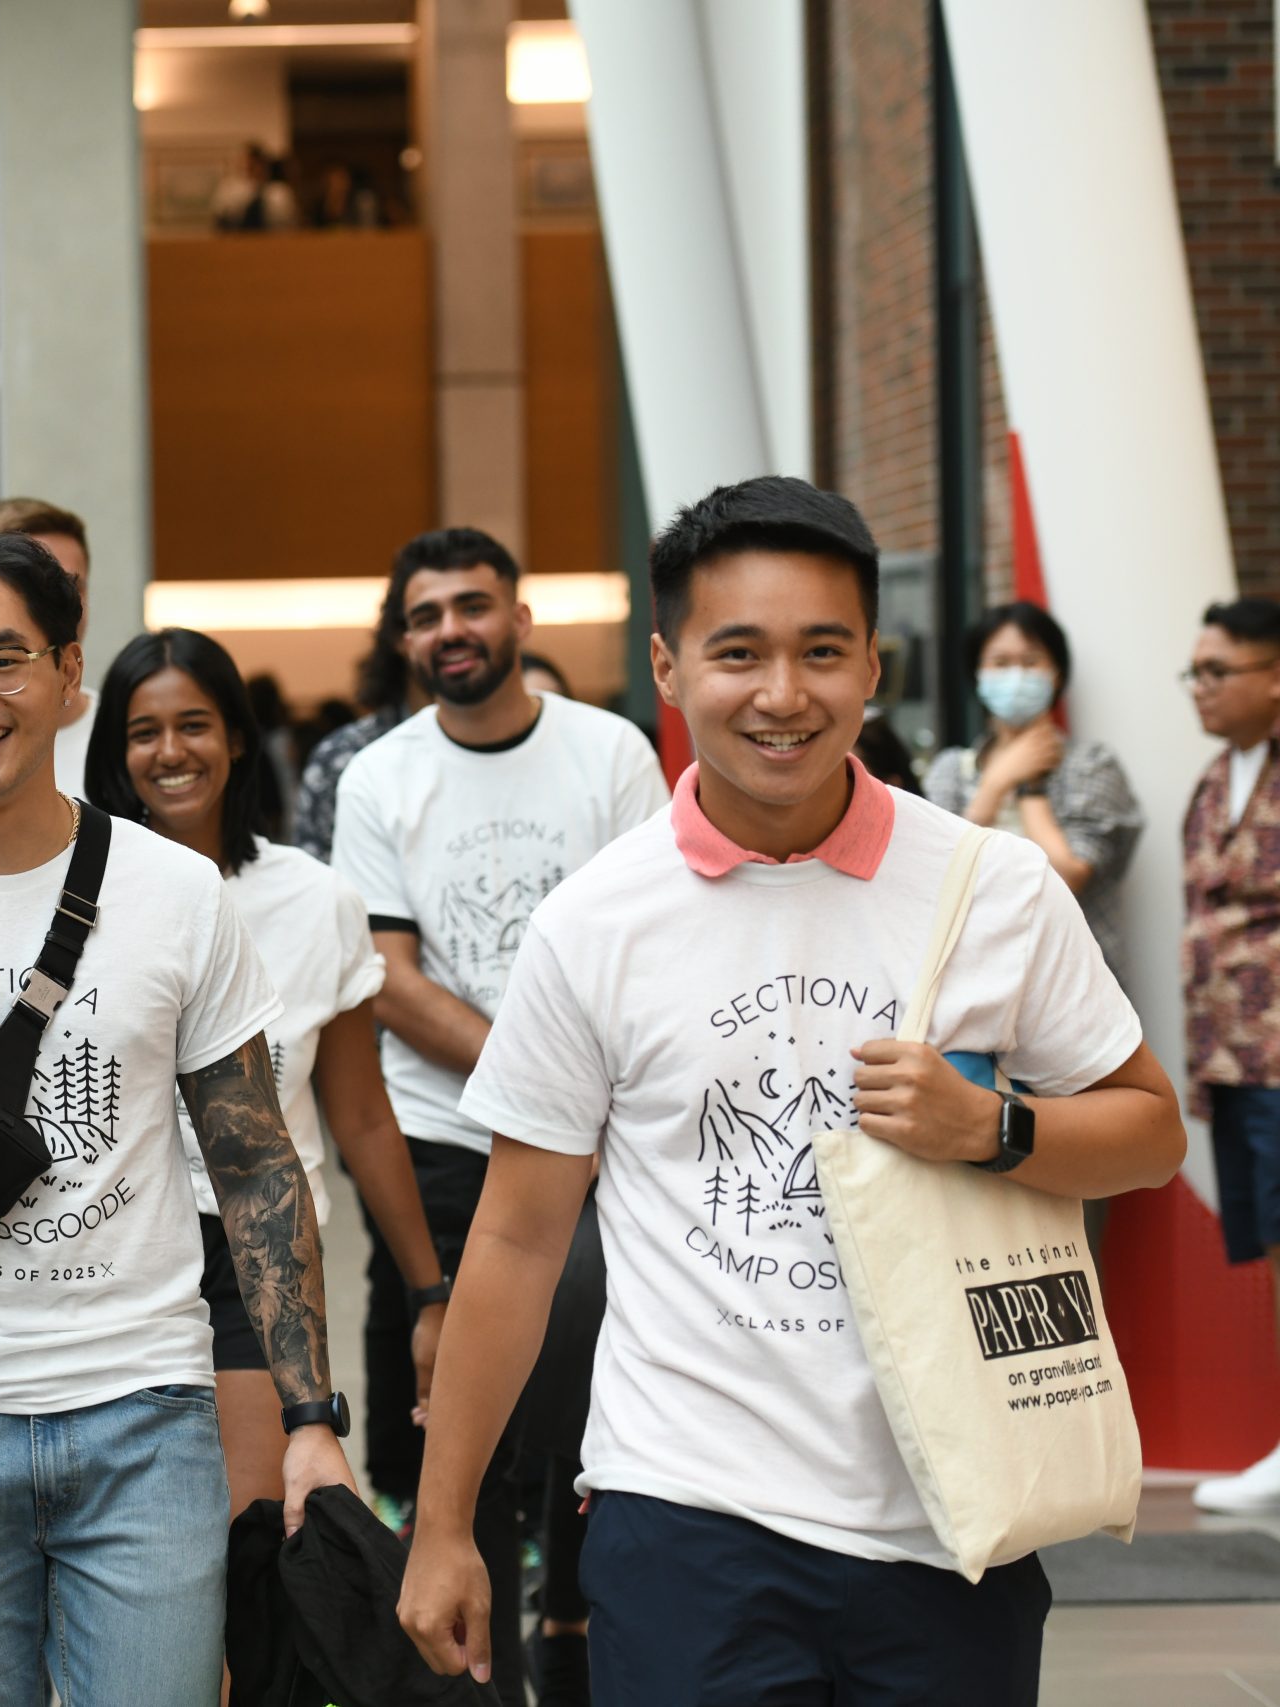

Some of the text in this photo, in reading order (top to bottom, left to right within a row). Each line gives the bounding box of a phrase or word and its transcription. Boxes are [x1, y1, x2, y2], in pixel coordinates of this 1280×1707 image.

[74, 987, 99, 1015] A
[710, 975, 899, 1038] SECTION A
[685, 1226, 779, 1284] CAMP
[955, 1241, 1079, 1274] the original
[14, 1268, 40, 1281] OF
[50, 1265, 96, 1281] 2025
[734, 1314, 846, 1332] CLASS OF
[968, 1284, 1065, 1356] PAPER
[1008, 1371, 1027, 1386] on
